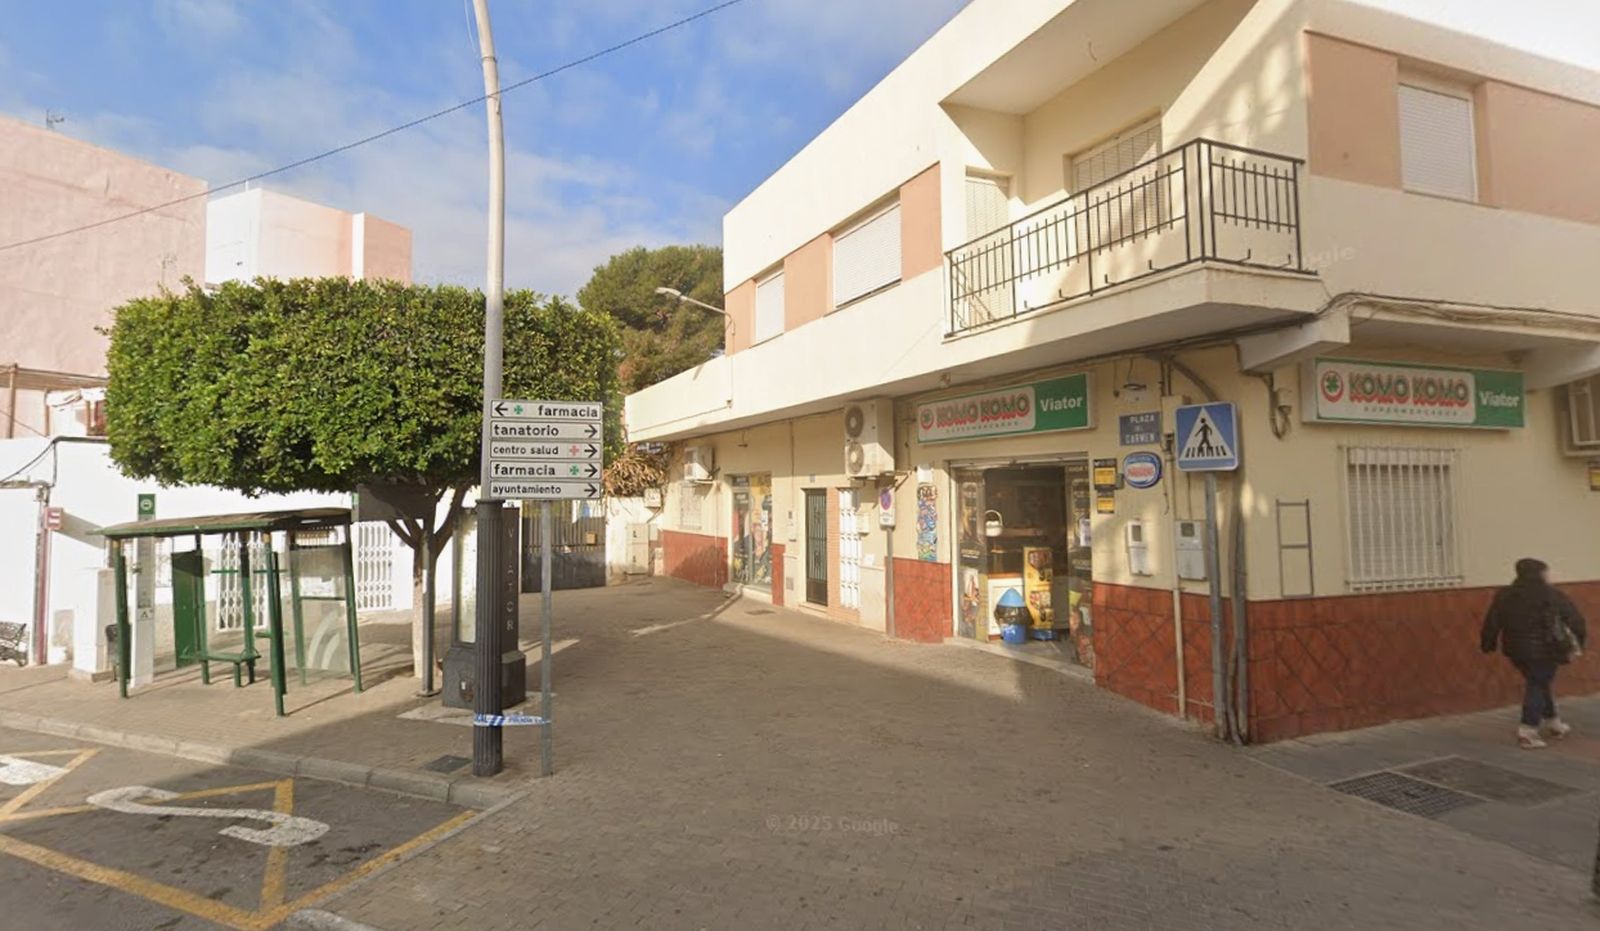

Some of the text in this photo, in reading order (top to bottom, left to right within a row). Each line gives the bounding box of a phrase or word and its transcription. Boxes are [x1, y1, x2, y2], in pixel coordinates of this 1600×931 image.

[1348, 371, 1469, 407] KOMO KOMO
[1040, 396, 1083, 412] Viator
[1479, 391, 1520, 408] Viator
[538, 405, 598, 418] farmacia
[936, 393, 1030, 428] KOMO KOMO
[1129, 414, 1155, 424] PLAZA
[494, 424, 560, 436] tanatorio
[493, 446, 559, 455] centro salud
[494, 464, 556, 476] farmacia
[492, 485, 562, 495] ayuntamiento
